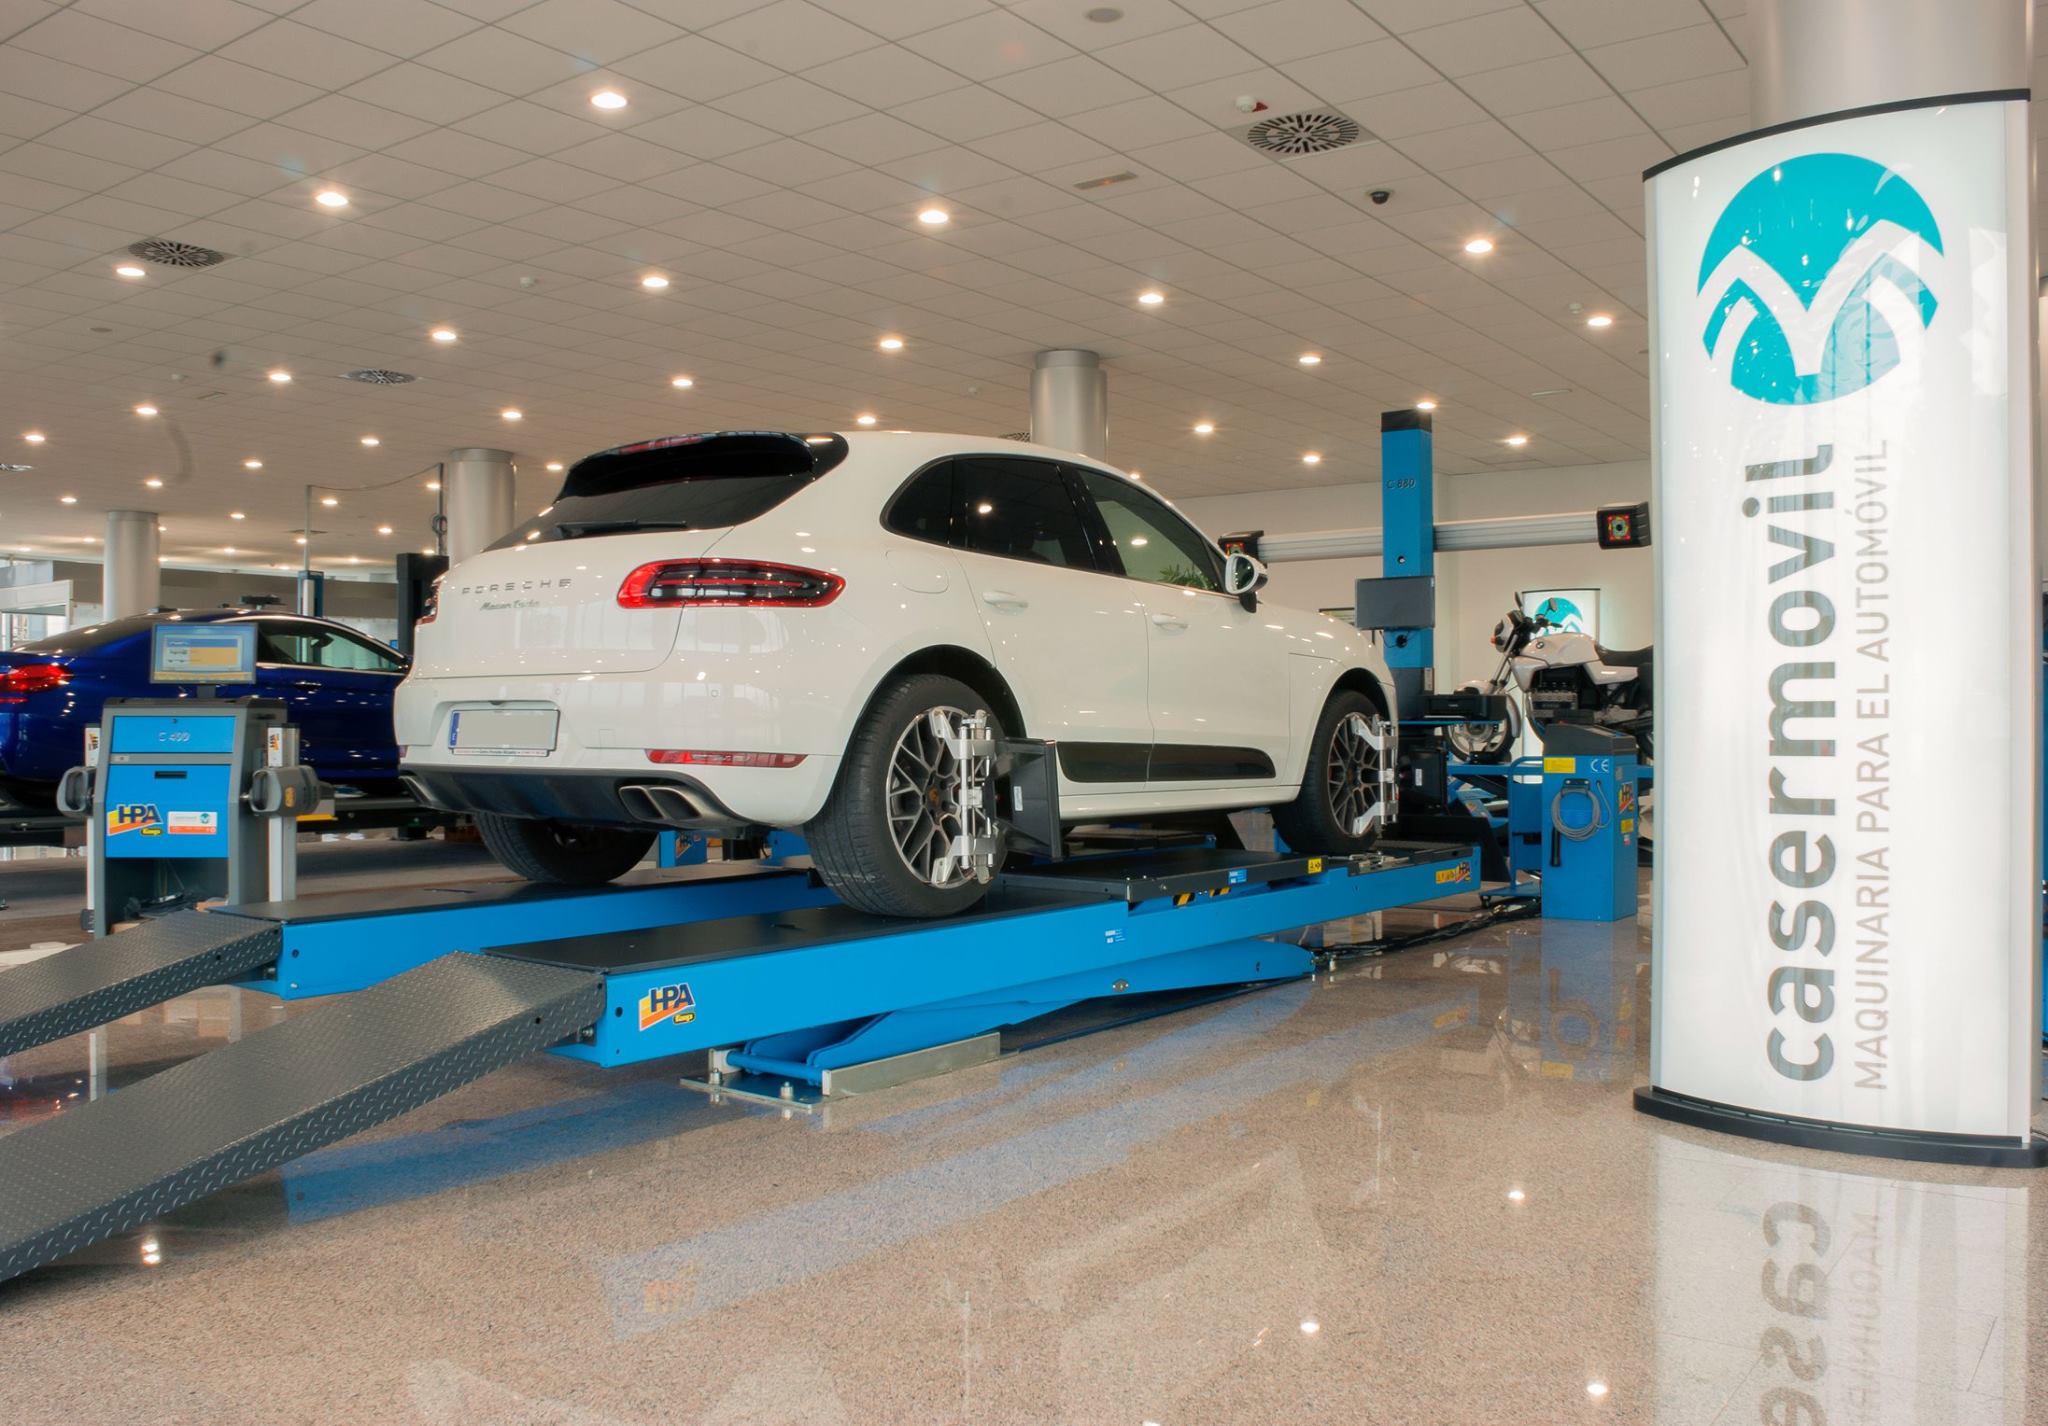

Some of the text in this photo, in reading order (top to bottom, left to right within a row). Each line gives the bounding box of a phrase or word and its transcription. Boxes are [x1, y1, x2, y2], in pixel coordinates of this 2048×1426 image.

[462, 578, 572, 595] PORSCHE
[1742, 444, 1837, 1082] casermovil
[1845, 440, 1890, 1090] MAQUINARIA PARA EL AUTOMÓVIL
[117, 804, 161, 824] HPA
[650, 983, 695, 1013] HPA
